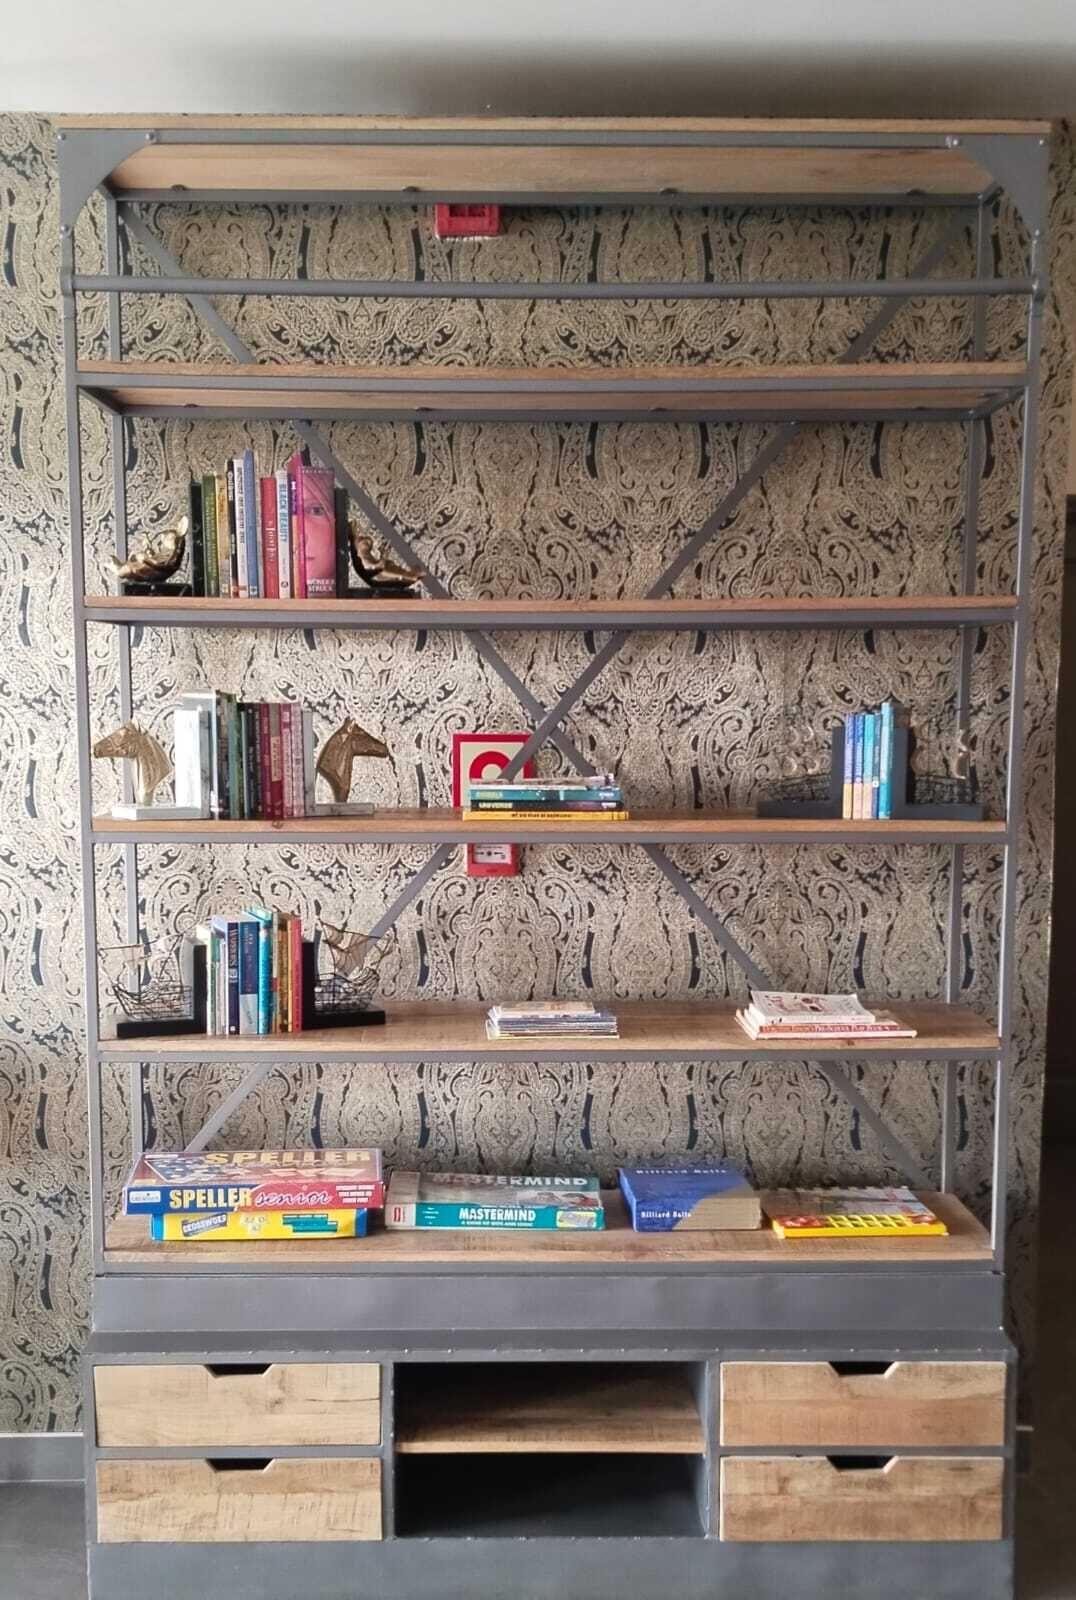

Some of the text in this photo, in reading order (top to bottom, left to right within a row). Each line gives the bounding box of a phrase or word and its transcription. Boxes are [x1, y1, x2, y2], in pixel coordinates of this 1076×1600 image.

[205, 1151, 370, 1164] SPELLER
[169, 1188, 252, 1209] SPELLER
[255, 1185, 333, 1207] senior
[458, 1207, 537, 1222] MASTERMIND
[641, 1210, 692, 1219] Billiard Balls
